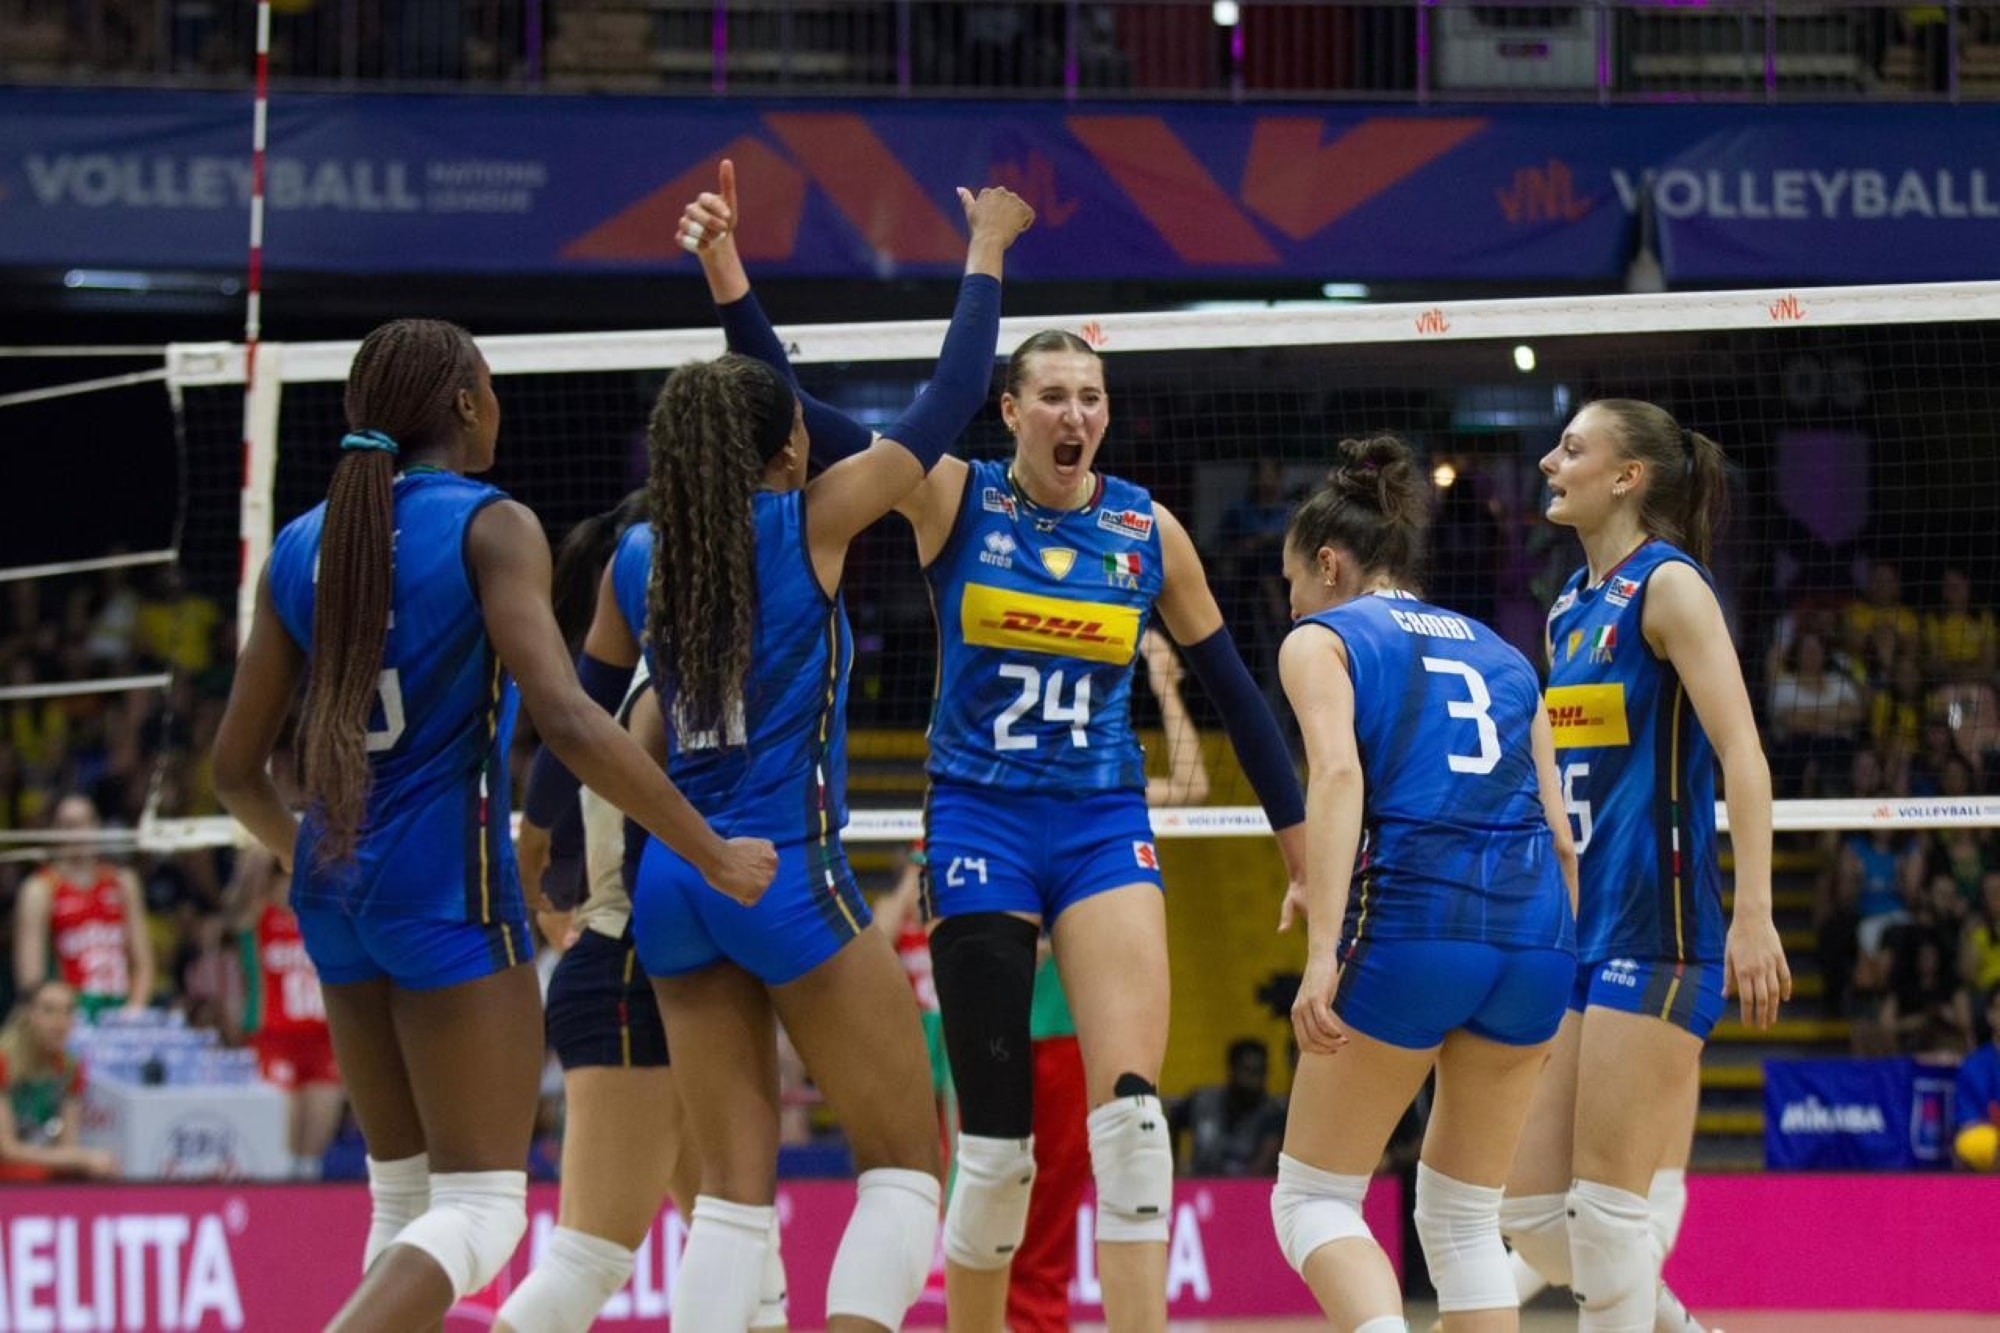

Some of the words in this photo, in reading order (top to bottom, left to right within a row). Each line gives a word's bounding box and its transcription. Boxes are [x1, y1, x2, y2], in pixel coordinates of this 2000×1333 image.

[1611, 168, 2000, 219] VOLLEYBALL
[1108, 574, 1138, 590] ITA
[1001, 611, 1107, 642] DHL
[1391, 610, 1476, 641] CAMBI
[1588, 648, 1613, 664] ITA
[994, 663, 1092, 750] 24
[1422, 656, 1502, 775] 3
[1899, 805, 1981, 817] VOLLEYBALL
[946, 857, 988, 887] 24
[0, 1215, 244, 1333] ELITTA
